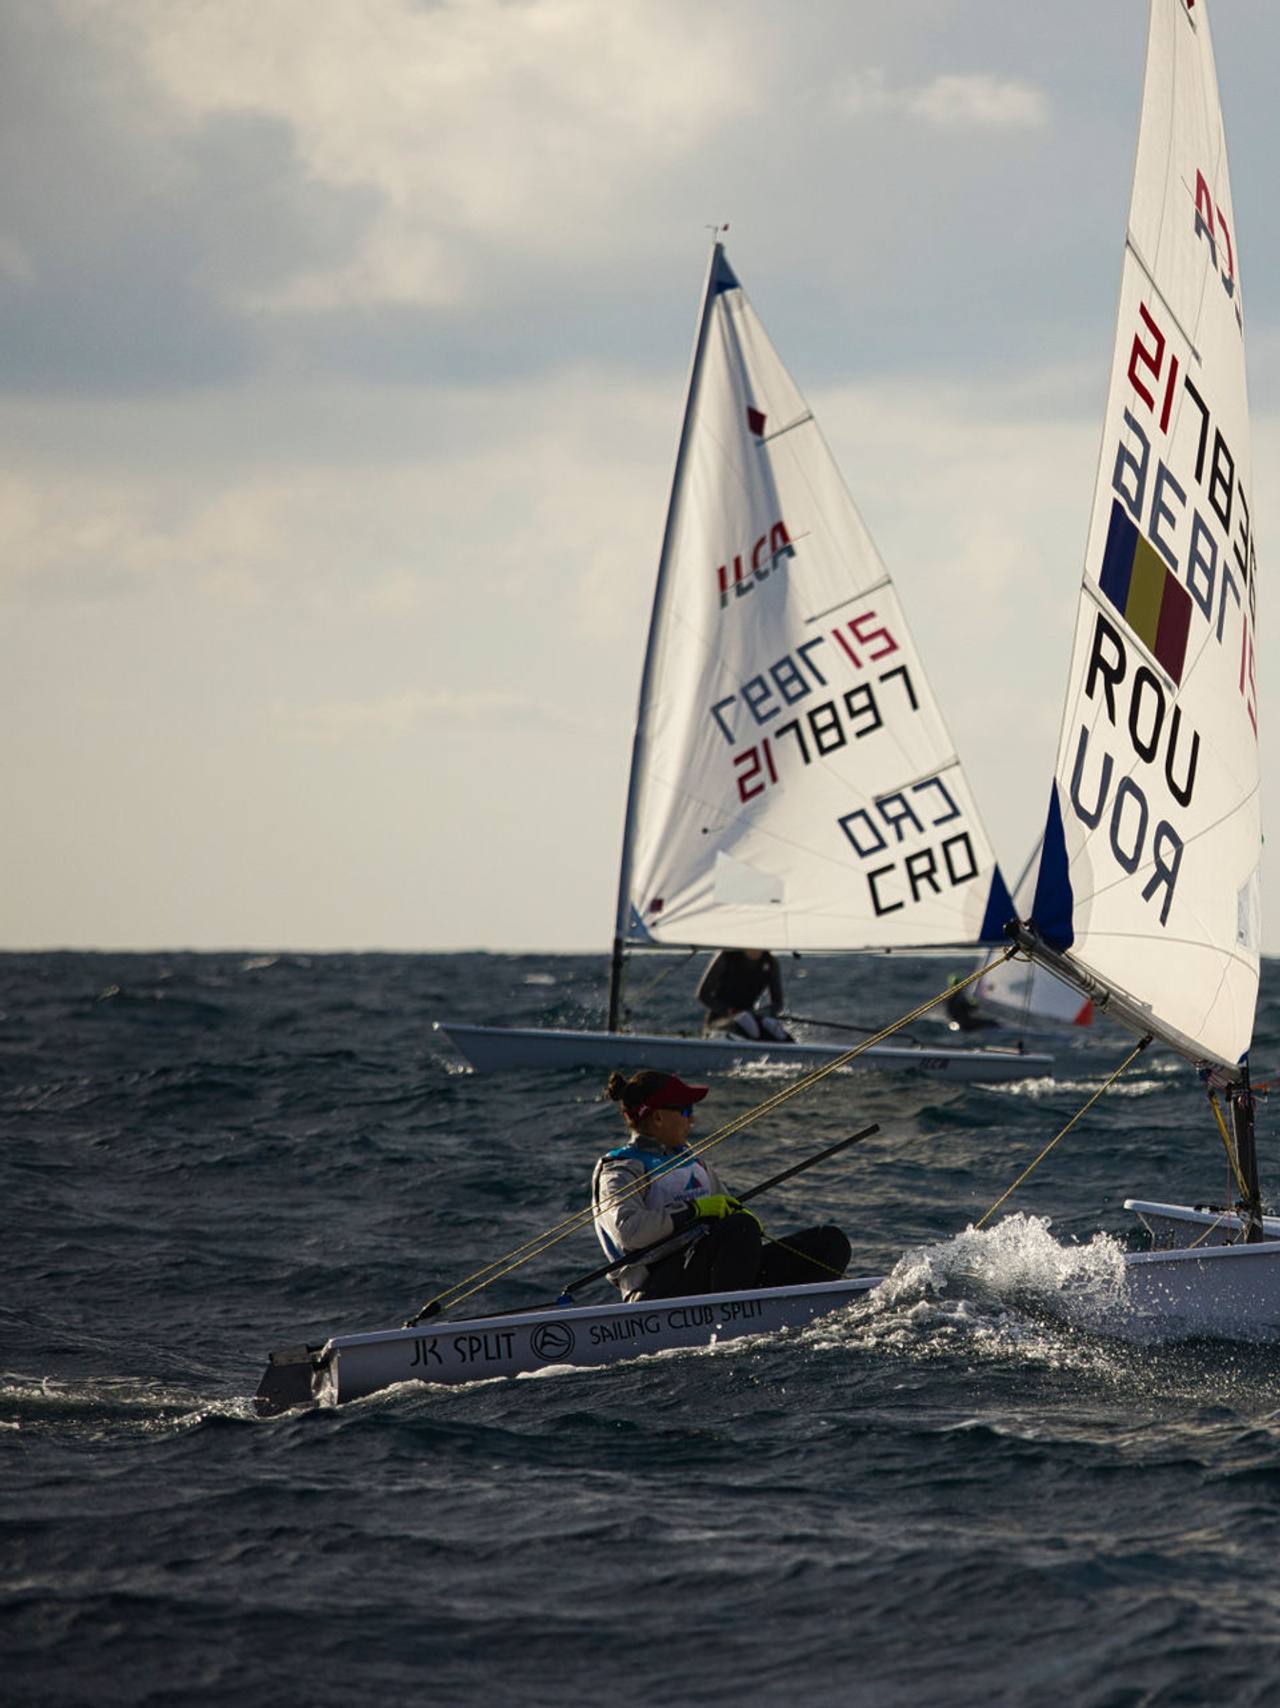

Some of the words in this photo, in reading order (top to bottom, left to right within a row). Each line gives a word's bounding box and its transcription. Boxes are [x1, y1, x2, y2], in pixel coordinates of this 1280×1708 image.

[717, 520, 796, 608] ILCA
[733, 664, 920, 803] 217897
[1085, 612, 1200, 808] ROU
[866, 831, 980, 917] CRO
[410, 1339, 443, 1367] JK
[454, 1333, 515, 1362] SPLIT
[589, 1314, 660, 1345] SAILING
[667, 1304, 714, 1331] CLUB
[721, 1299, 764, 1322] SPLIT
